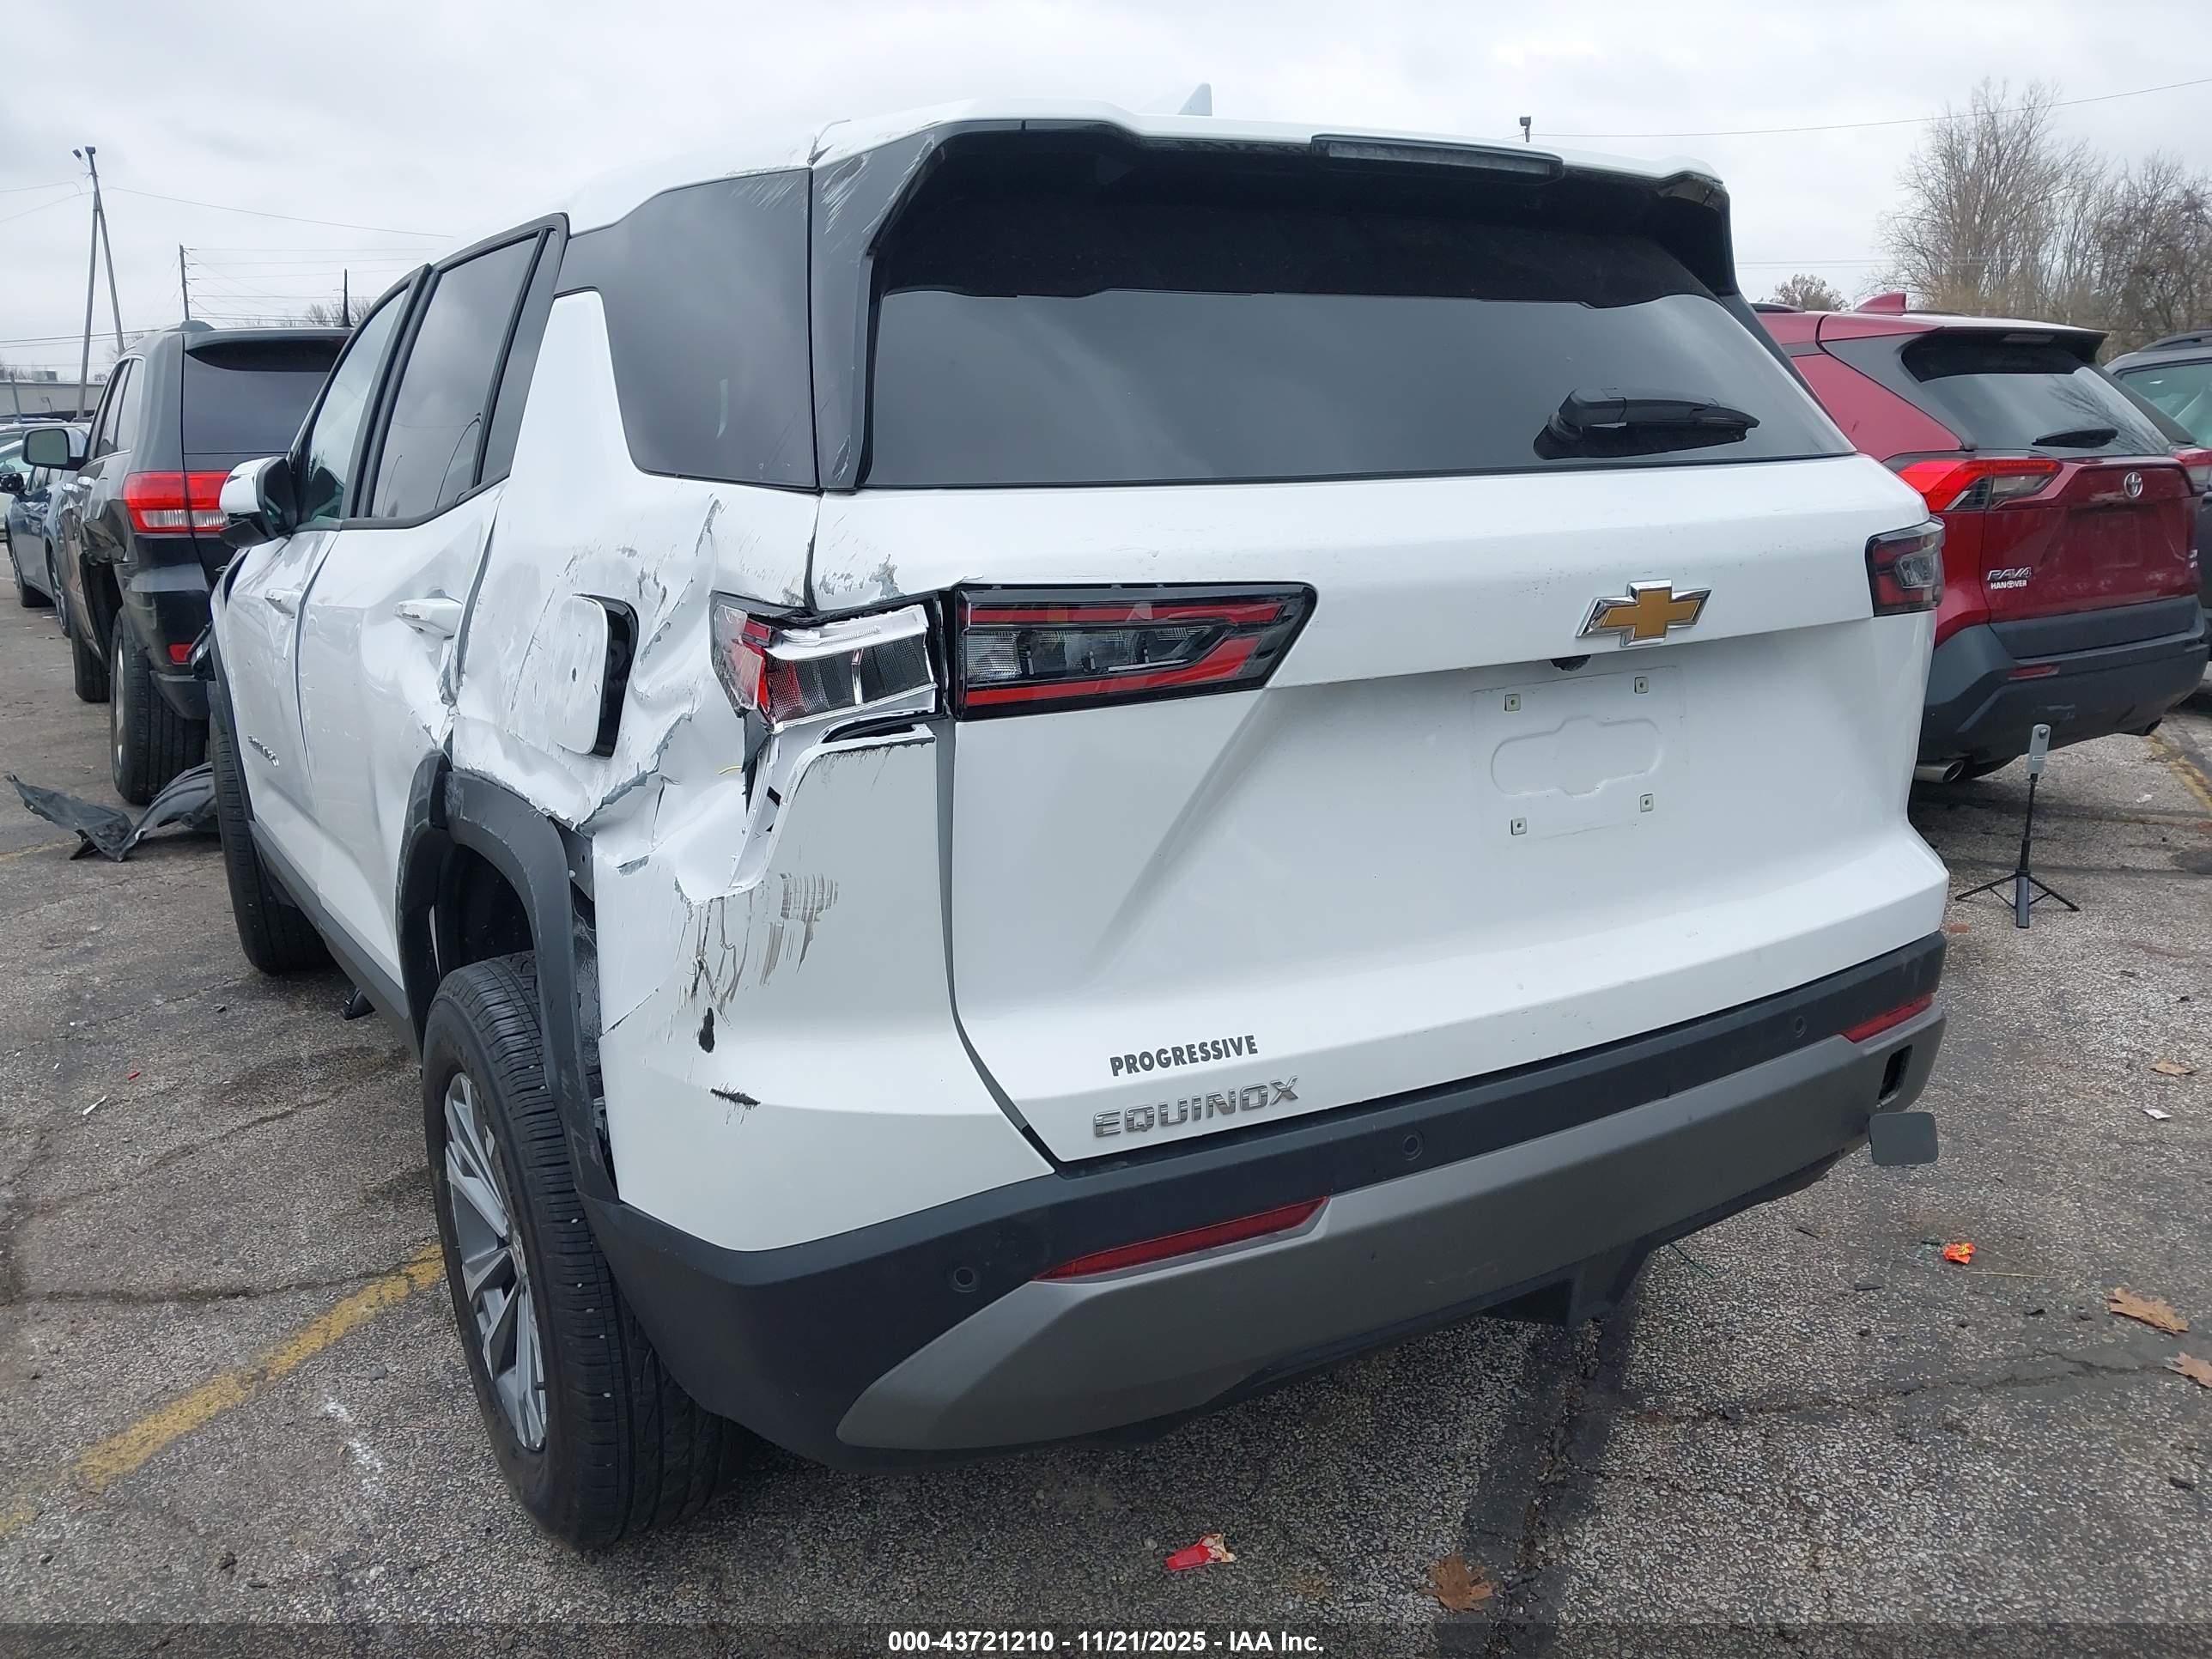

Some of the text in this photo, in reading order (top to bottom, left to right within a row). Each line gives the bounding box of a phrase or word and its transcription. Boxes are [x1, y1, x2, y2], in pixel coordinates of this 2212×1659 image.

[1990, 580, 2027, 590] HANOVER
[1109, 1035, 1258, 1077] PROGRESSIVE
[1093, 1075, 1299, 1138] EQUINOX
